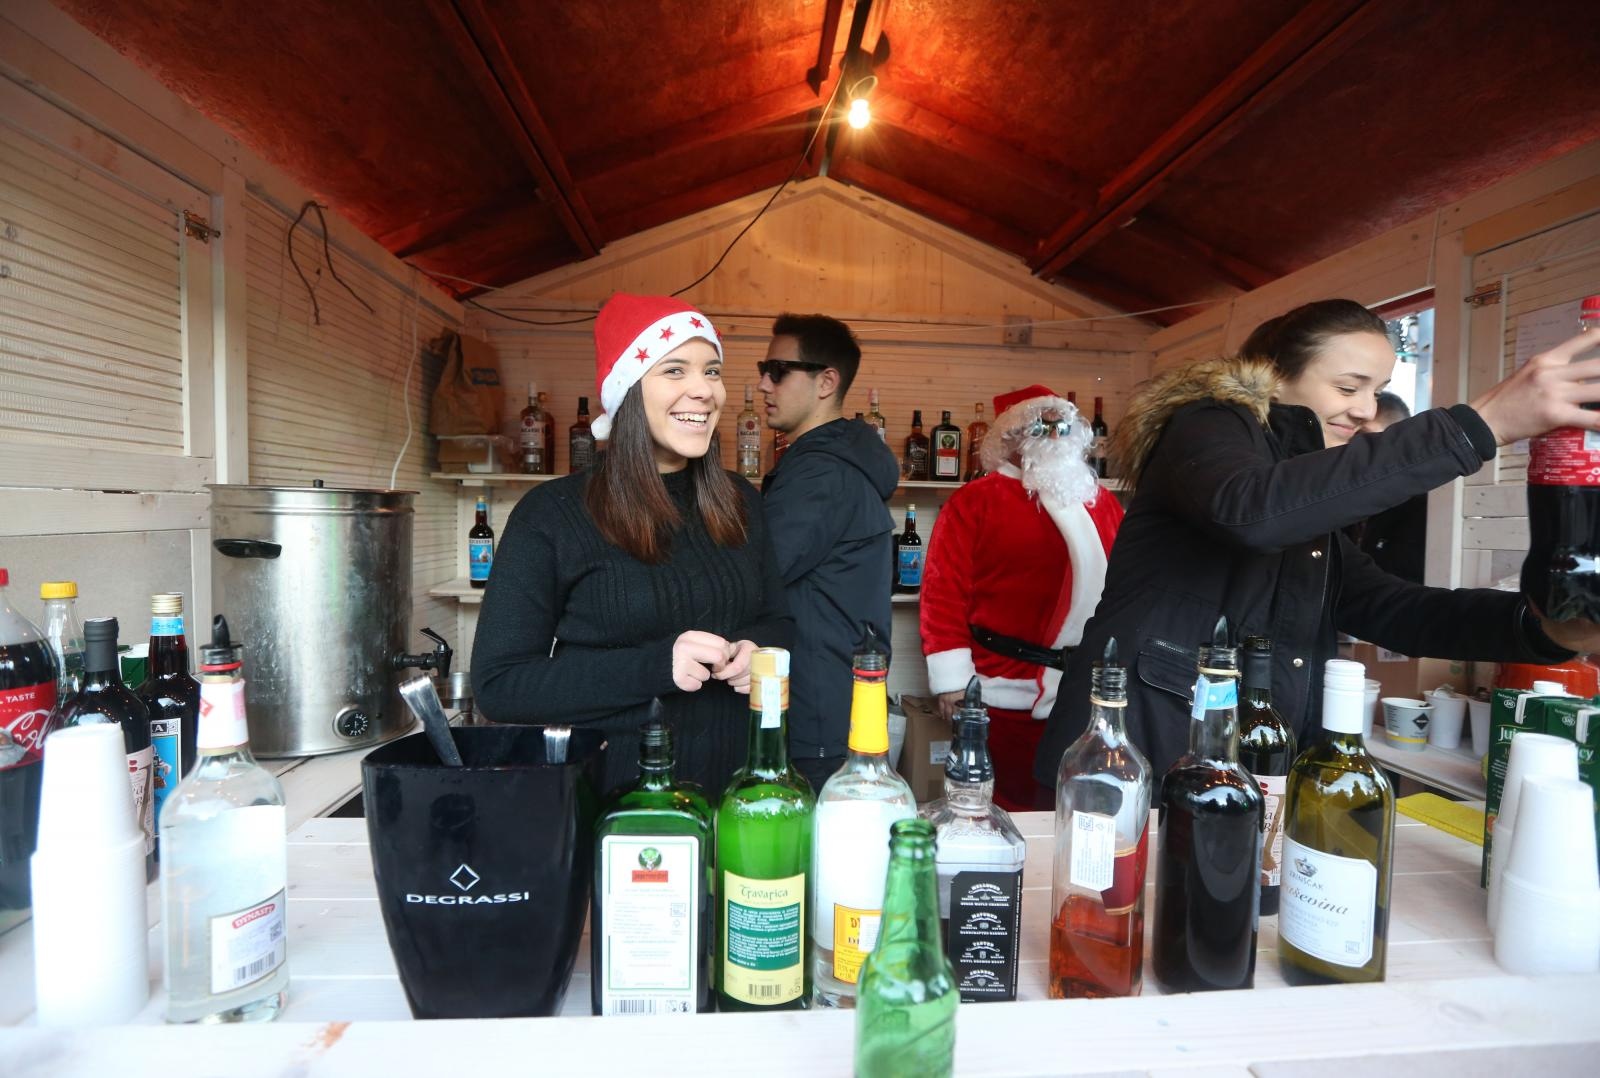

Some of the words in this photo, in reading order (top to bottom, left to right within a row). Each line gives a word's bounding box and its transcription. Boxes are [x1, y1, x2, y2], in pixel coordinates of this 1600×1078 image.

[6, 692, 36, 703] TASTE
[406, 891, 529, 905] DEGRASSI
[739, 884, 788, 900] Travarica
